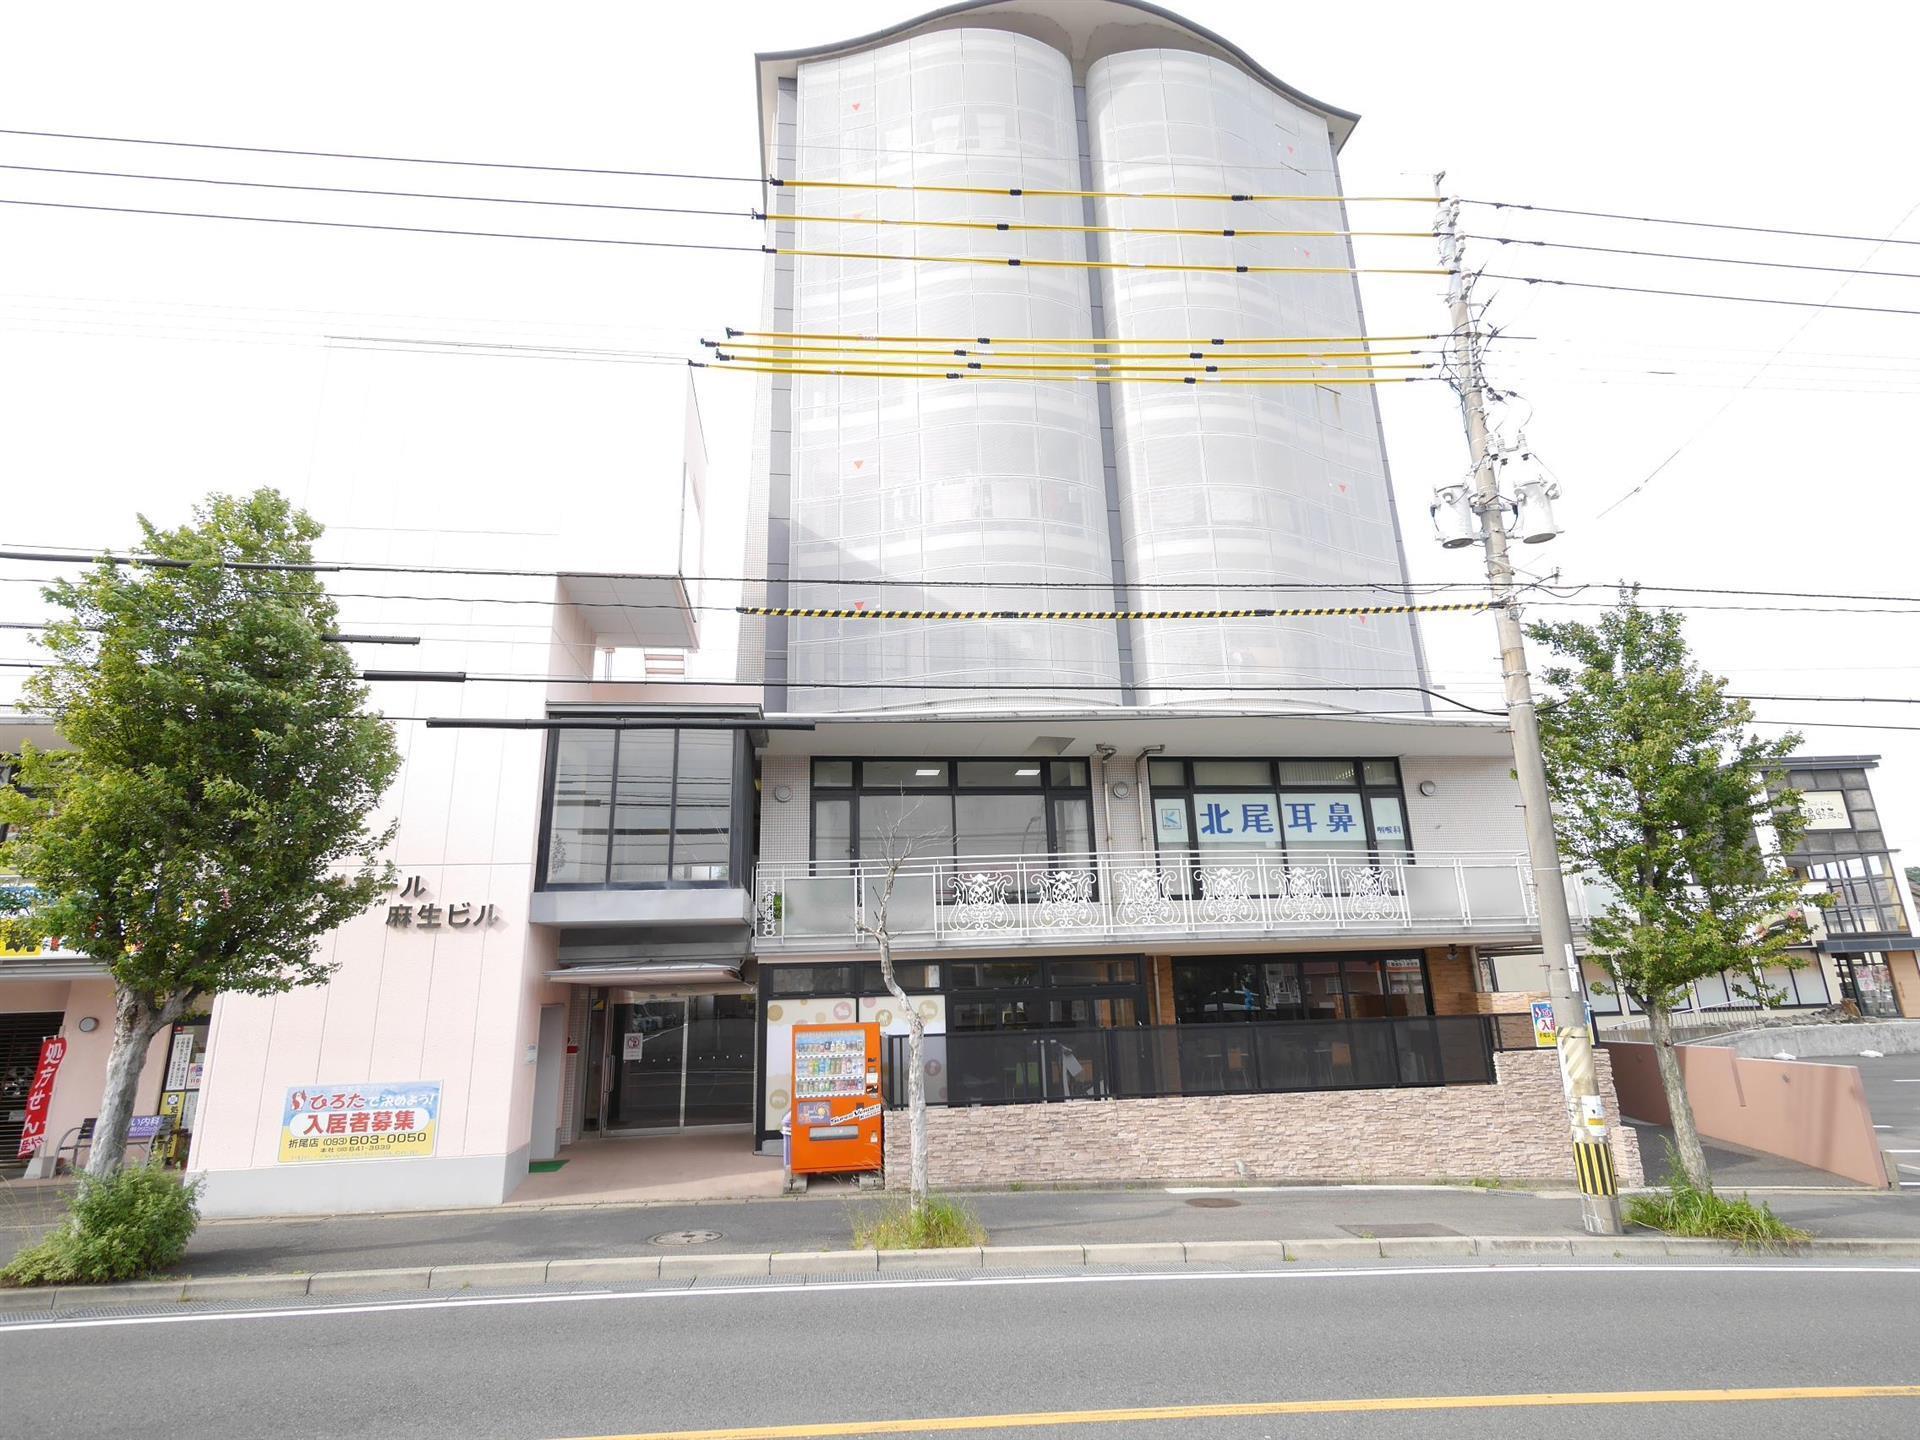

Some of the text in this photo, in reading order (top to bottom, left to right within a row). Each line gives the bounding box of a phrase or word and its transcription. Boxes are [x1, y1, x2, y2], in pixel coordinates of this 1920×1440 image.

[1200, 802, 1357, 835] 北尾耳鼻
[386, 902, 500, 929] 麻生ビル
[22, 1043, 63, 1137] 処方せん
[303, 1110, 415, 1135] 入居者募集
[288, 1138, 319, 1149] 折尾店
